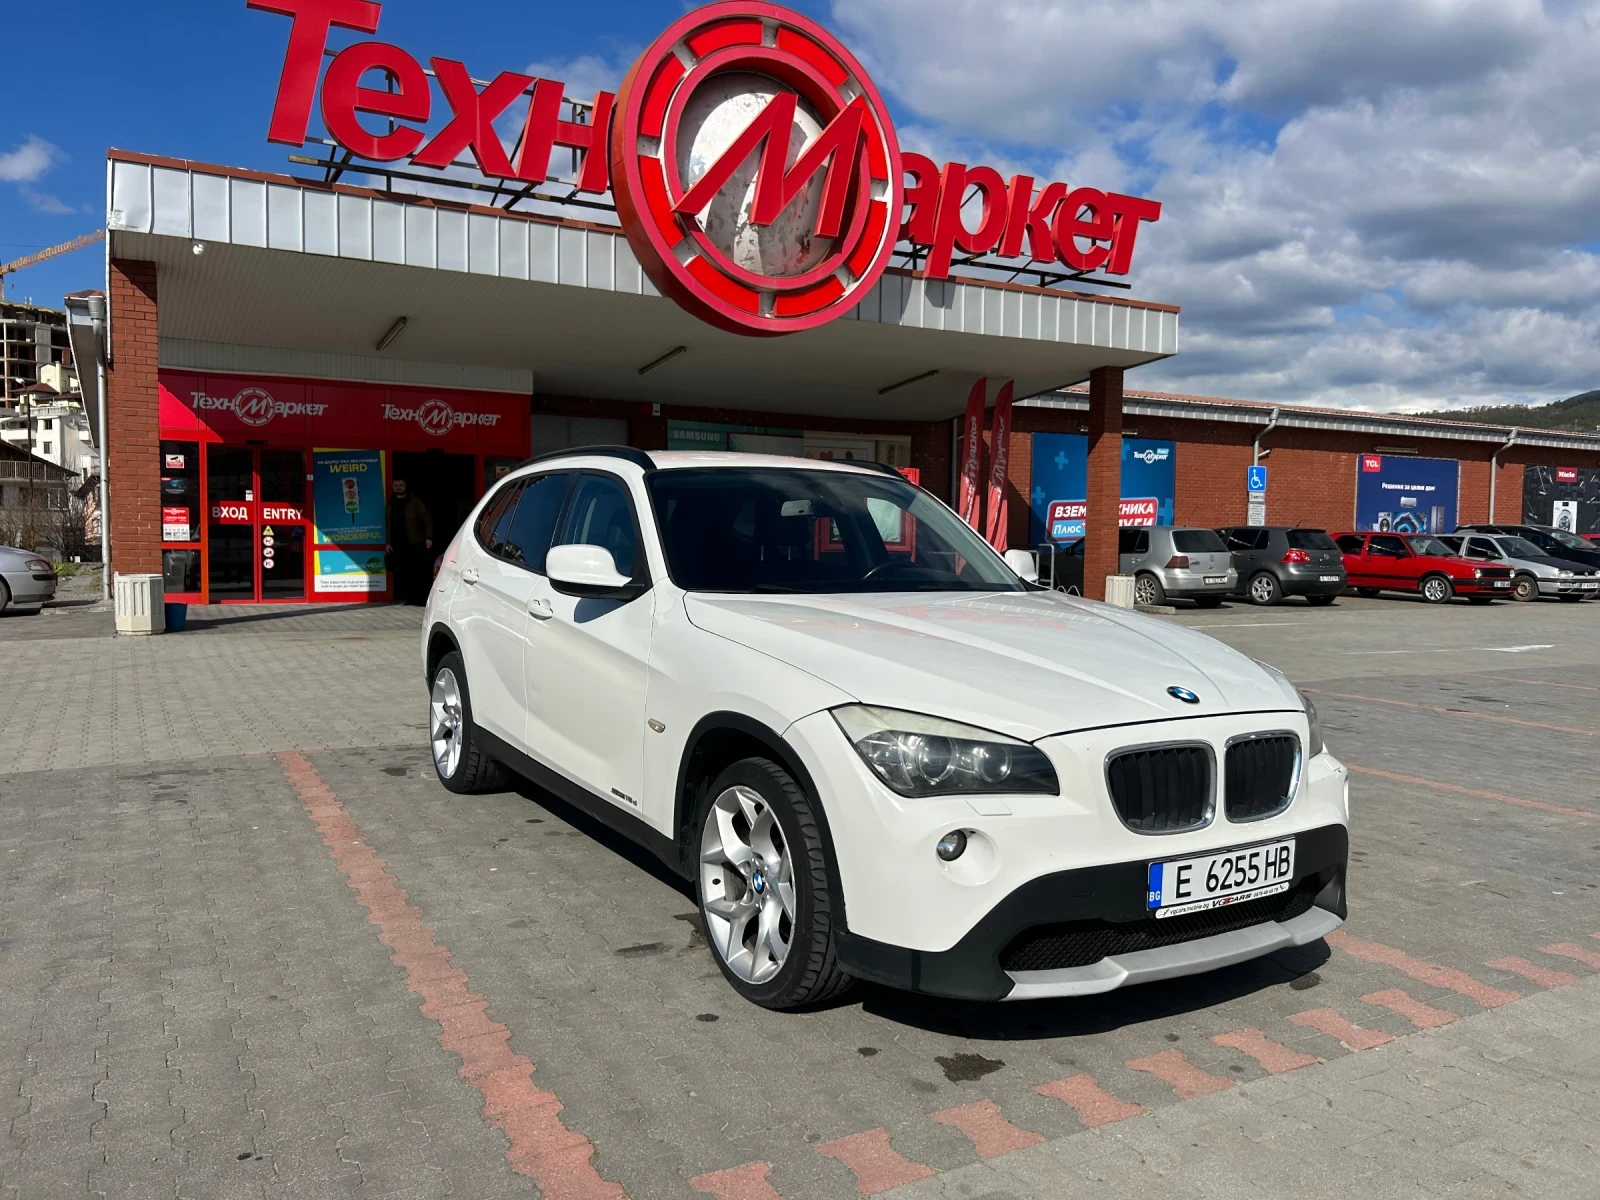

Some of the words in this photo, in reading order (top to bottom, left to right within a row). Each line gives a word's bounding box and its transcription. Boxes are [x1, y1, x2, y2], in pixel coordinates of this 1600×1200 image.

[673, 430, 720, 442] SAMSUNG
[329, 463, 368, 473] WEIRD
[1365, 460, 1379, 468] TCL
[1381, 482, 1404, 490] Решения
[212, 506, 248, 520] ВХОД
[263, 507, 303, 520] ENTRY
[322, 531, 383, 543] WONDERFUL
[1175, 864, 1193, 899] E
[1205, 851, 1260, 893] 6255
[1263, 845, 1290, 881] HB
[1149, 891, 1161, 901] BG
